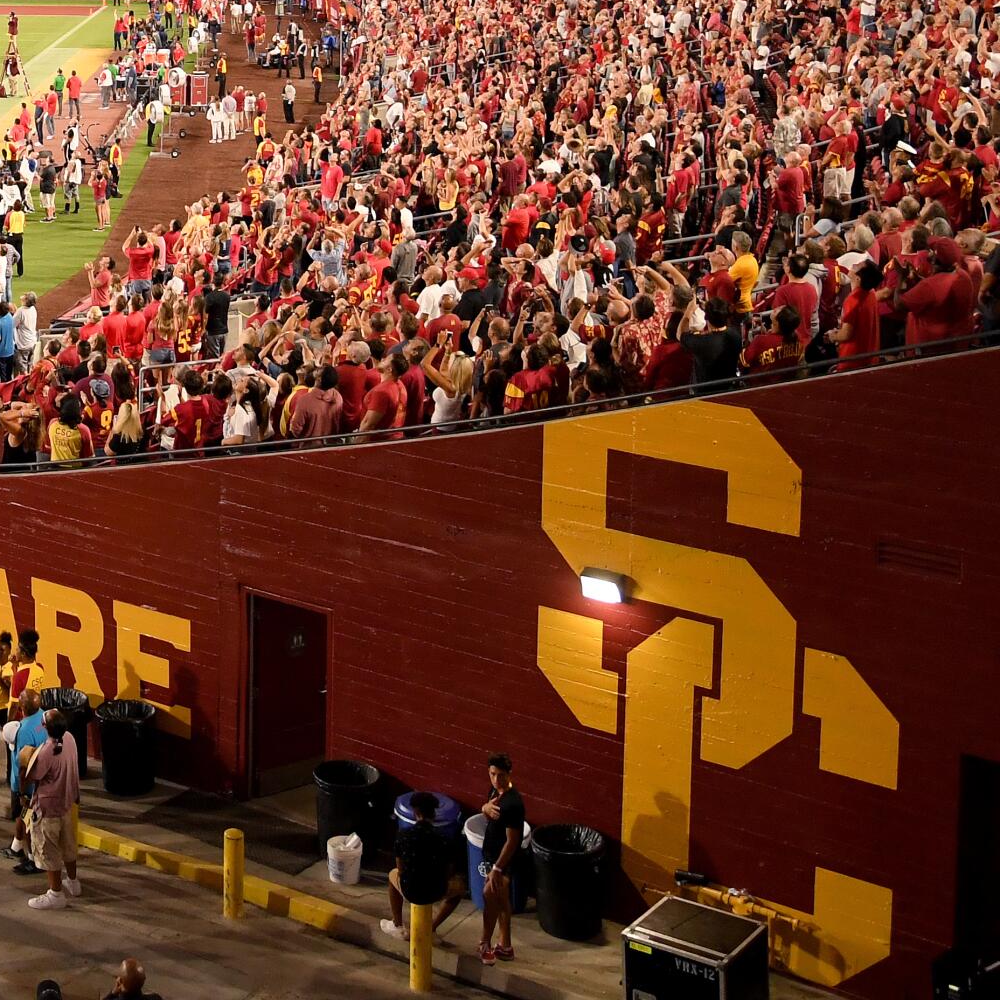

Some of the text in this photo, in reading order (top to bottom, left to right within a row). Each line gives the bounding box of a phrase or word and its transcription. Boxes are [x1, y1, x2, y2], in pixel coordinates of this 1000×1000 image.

[178, 329, 191, 353] 55
[55, 427, 72, 438] CSC
[195, 418, 202, 443] 1
[674, 957, 716, 981] VRX-12
